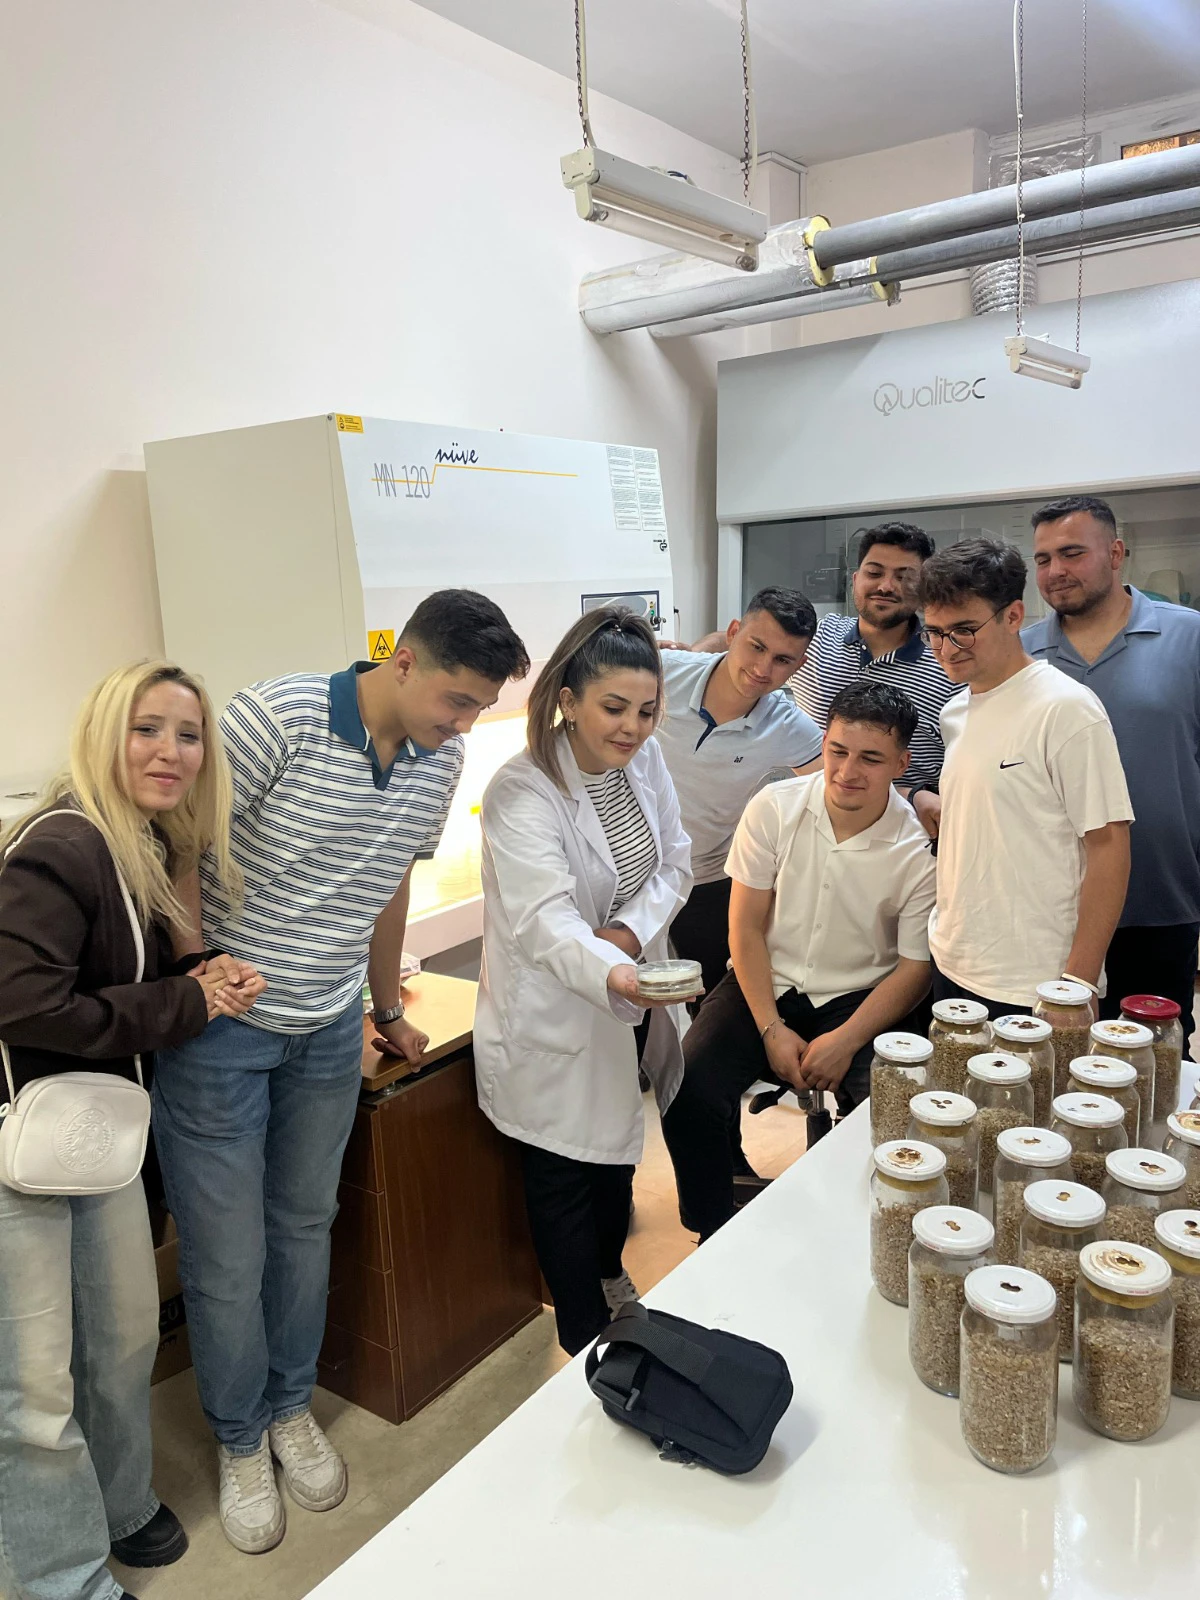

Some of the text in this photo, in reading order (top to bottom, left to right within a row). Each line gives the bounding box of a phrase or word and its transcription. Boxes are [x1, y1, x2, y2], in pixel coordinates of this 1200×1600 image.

[873, 375, 986, 417] Qualitec
[434, 441, 479, 465] nüve
[374, 462, 431, 499] MN 120
